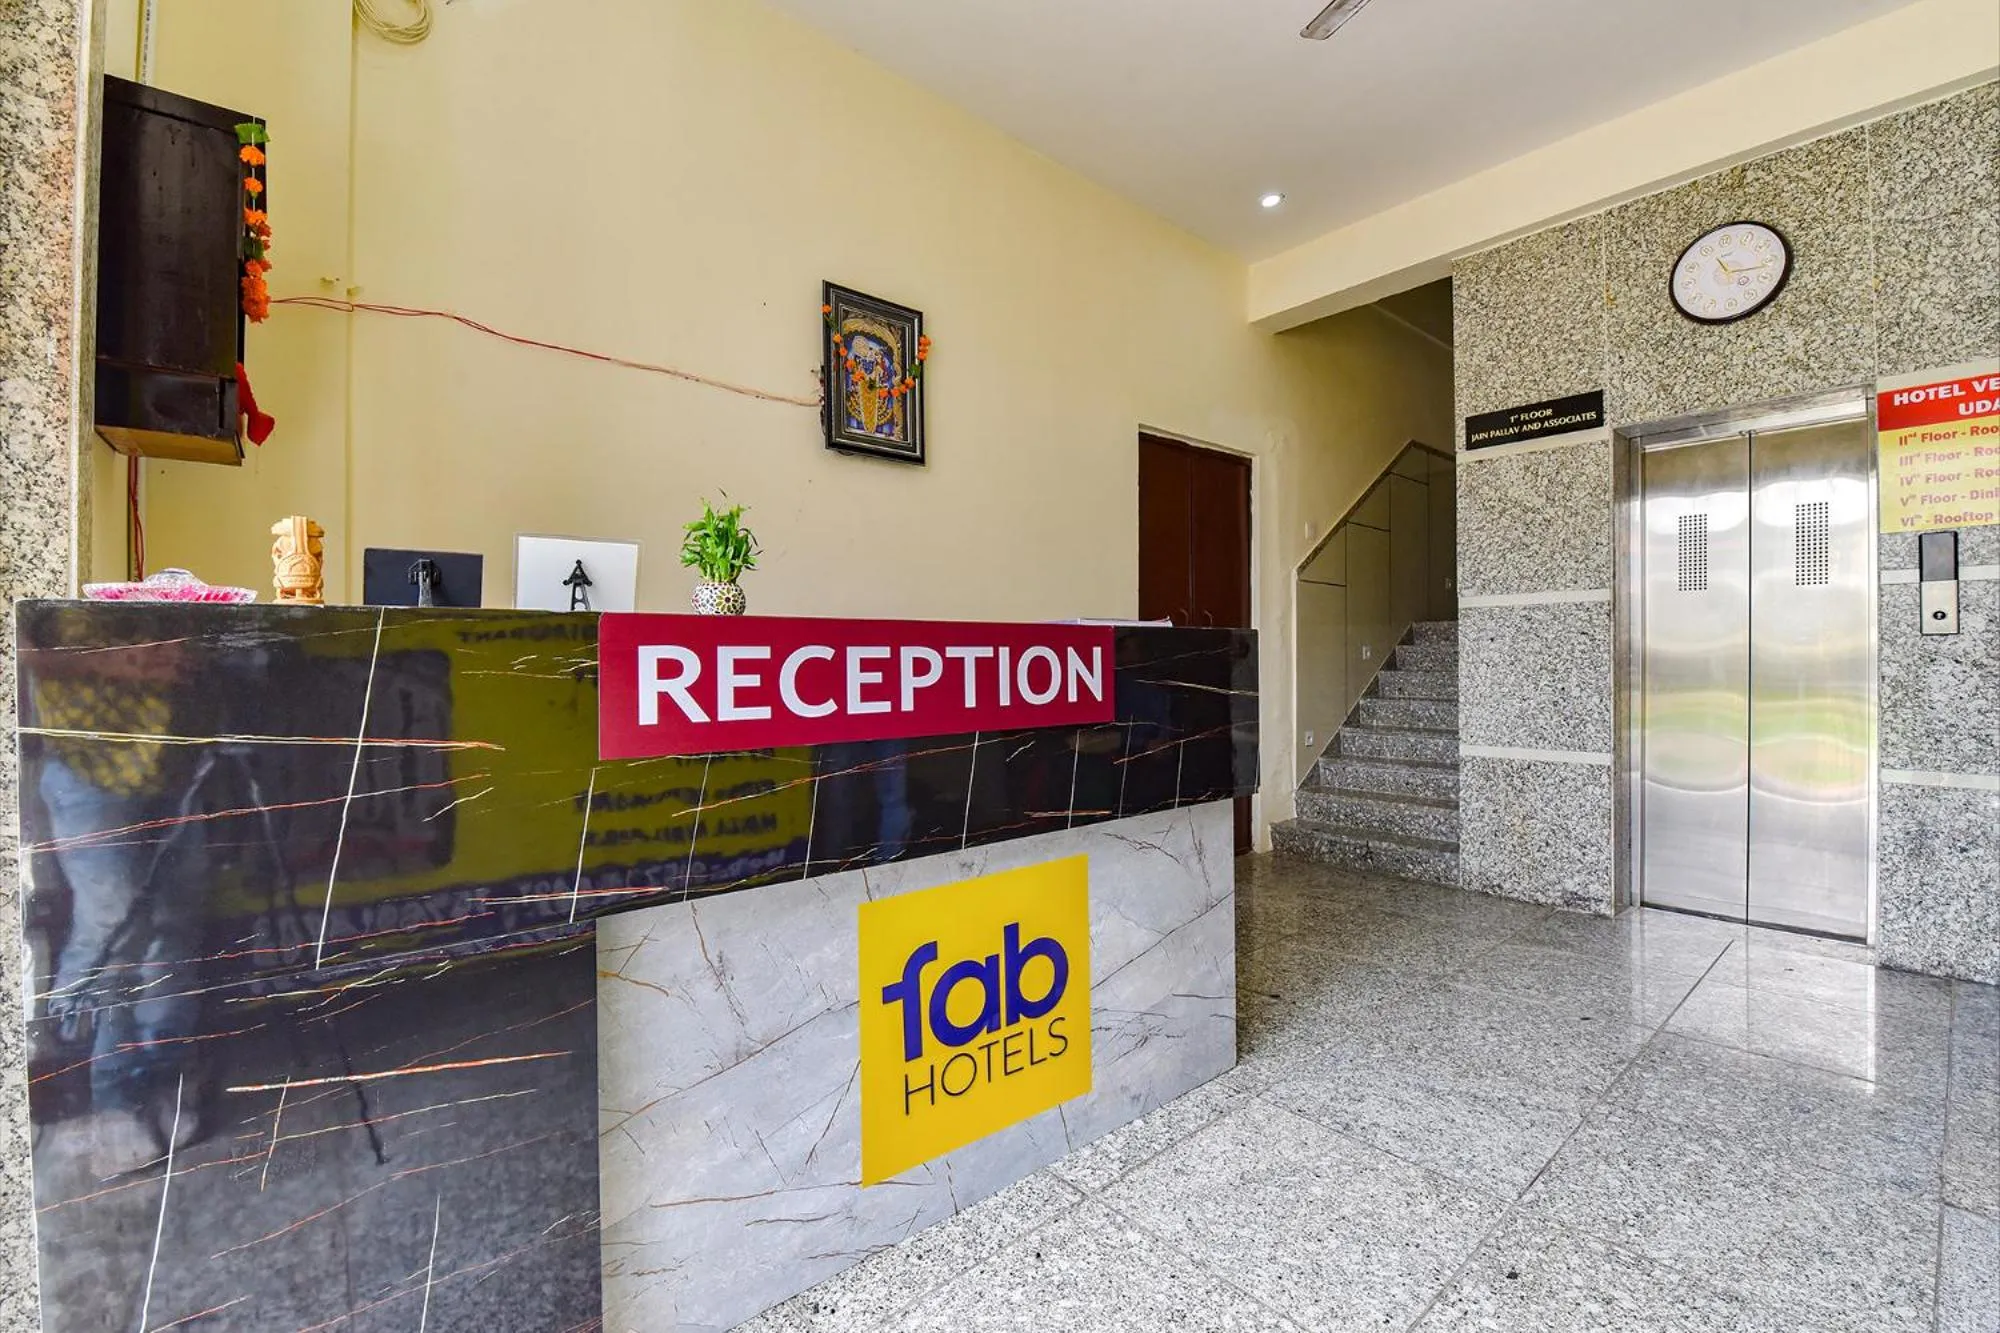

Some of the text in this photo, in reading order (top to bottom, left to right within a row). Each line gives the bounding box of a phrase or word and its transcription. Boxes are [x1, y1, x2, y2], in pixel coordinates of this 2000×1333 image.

[1894, 377, 2000, 406] HOTEL VE
[1520, 409, 1553, 421] FLOOR
[1471, 411, 1597, 443] JAIN PALLAV AND ASSOCIATES
[1921, 431, 1958, 443] Floor
[1925, 452, 1961, 463] Floor
[1925, 473, 1961, 484] Floor
[1921, 494, 1957, 505] Floor
[1934, 511, 1993, 524] Rooftop
[637, 645, 1103, 726] RECEPTION
[882, 922, 1069, 1062] fab
[904, 1016, 1069, 1116] HOTELS
